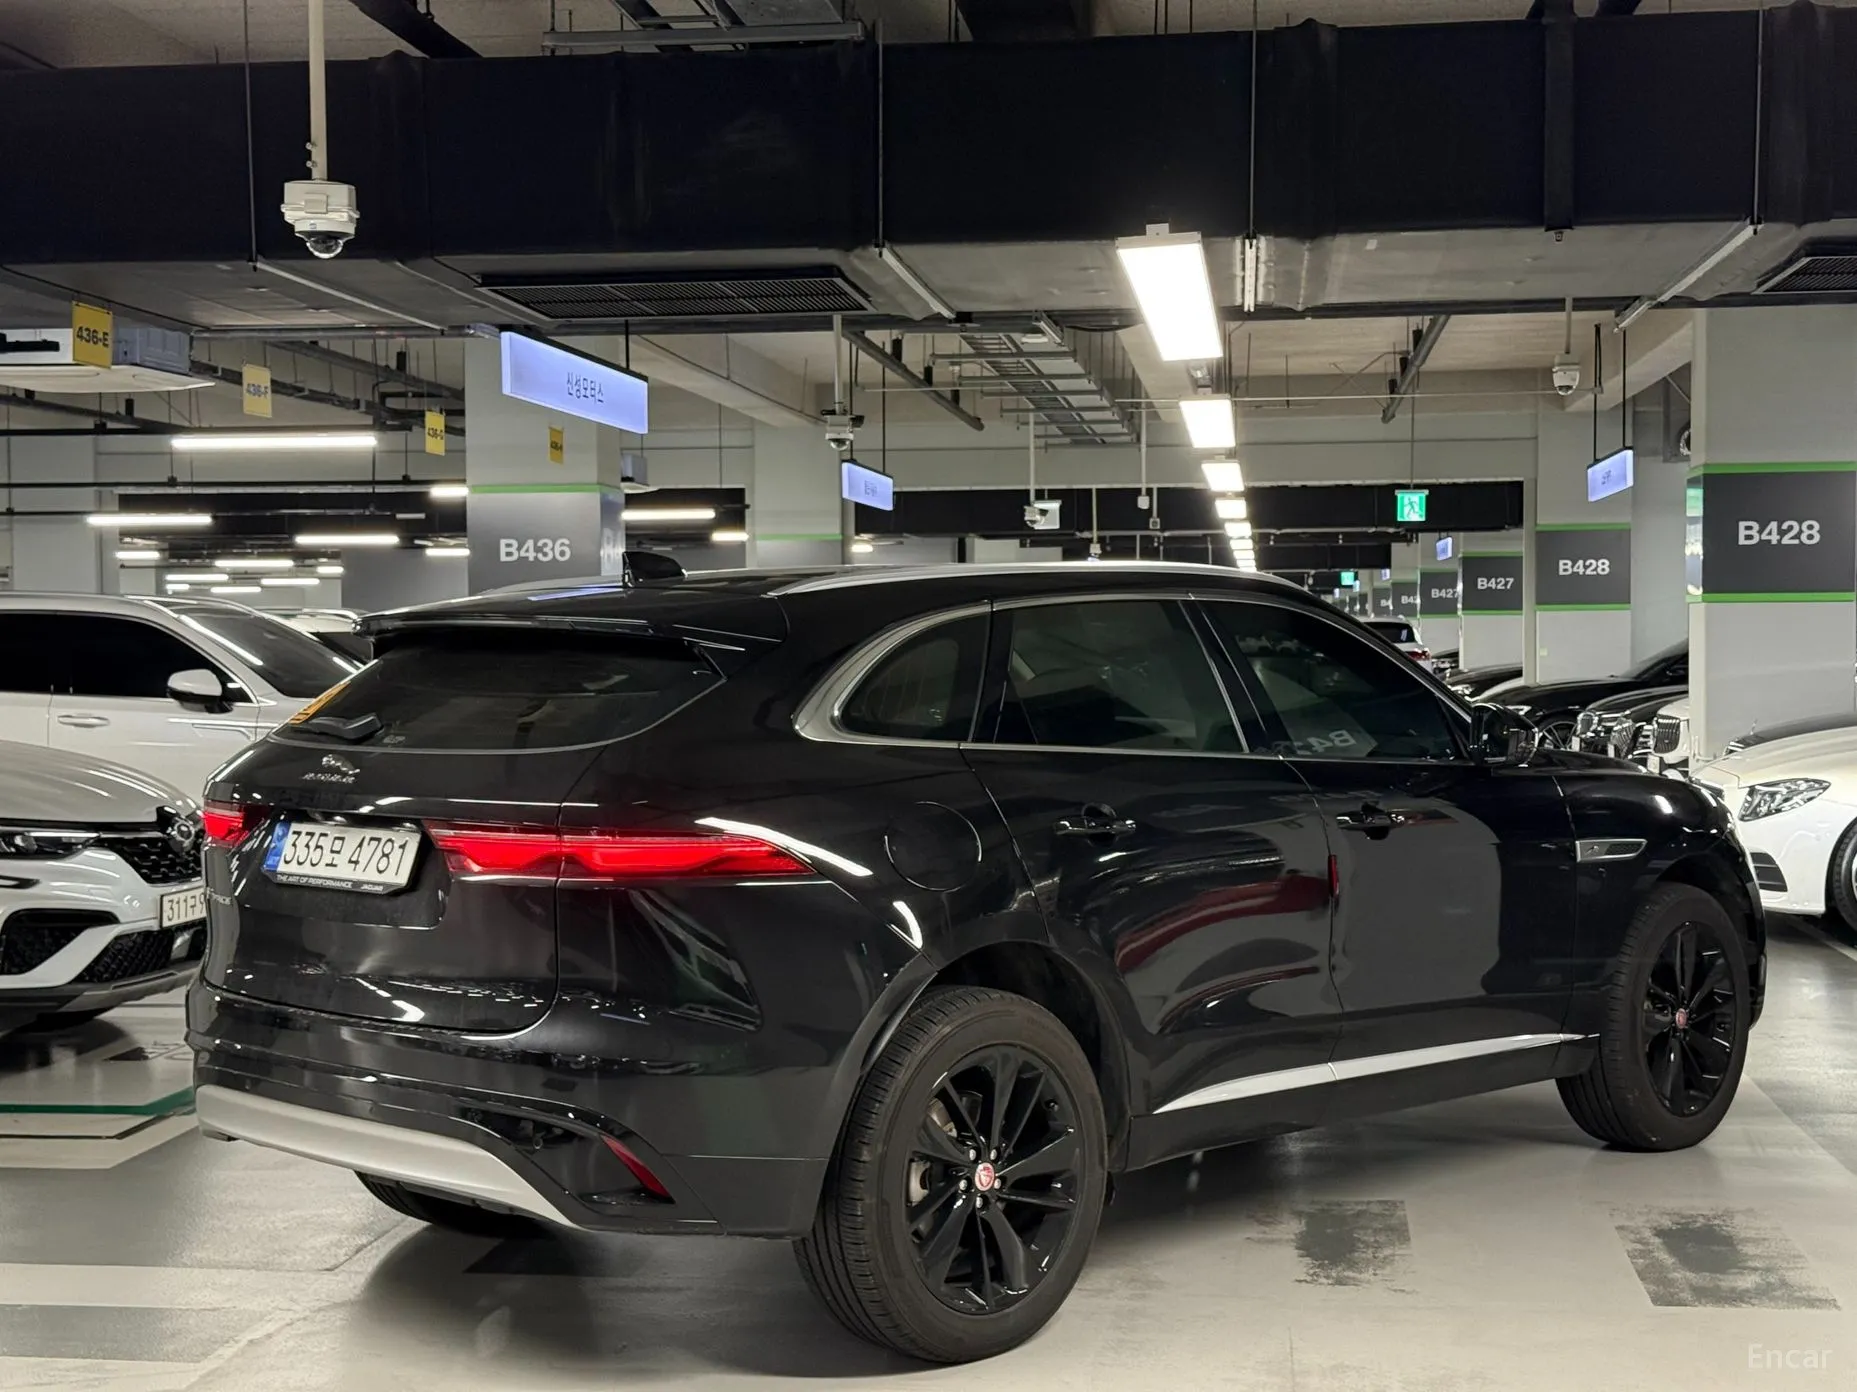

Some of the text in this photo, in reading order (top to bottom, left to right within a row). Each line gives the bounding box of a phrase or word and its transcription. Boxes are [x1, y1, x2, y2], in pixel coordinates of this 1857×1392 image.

[76, 326, 109, 348] 436-E
[1738, 520, 1821, 545] B428
[500, 538, 571, 561] B436
[1558, 559, 1610, 575] B428
[1477, 577, 1514, 590] B427
[284, 831, 408, 876] 335모 4781
